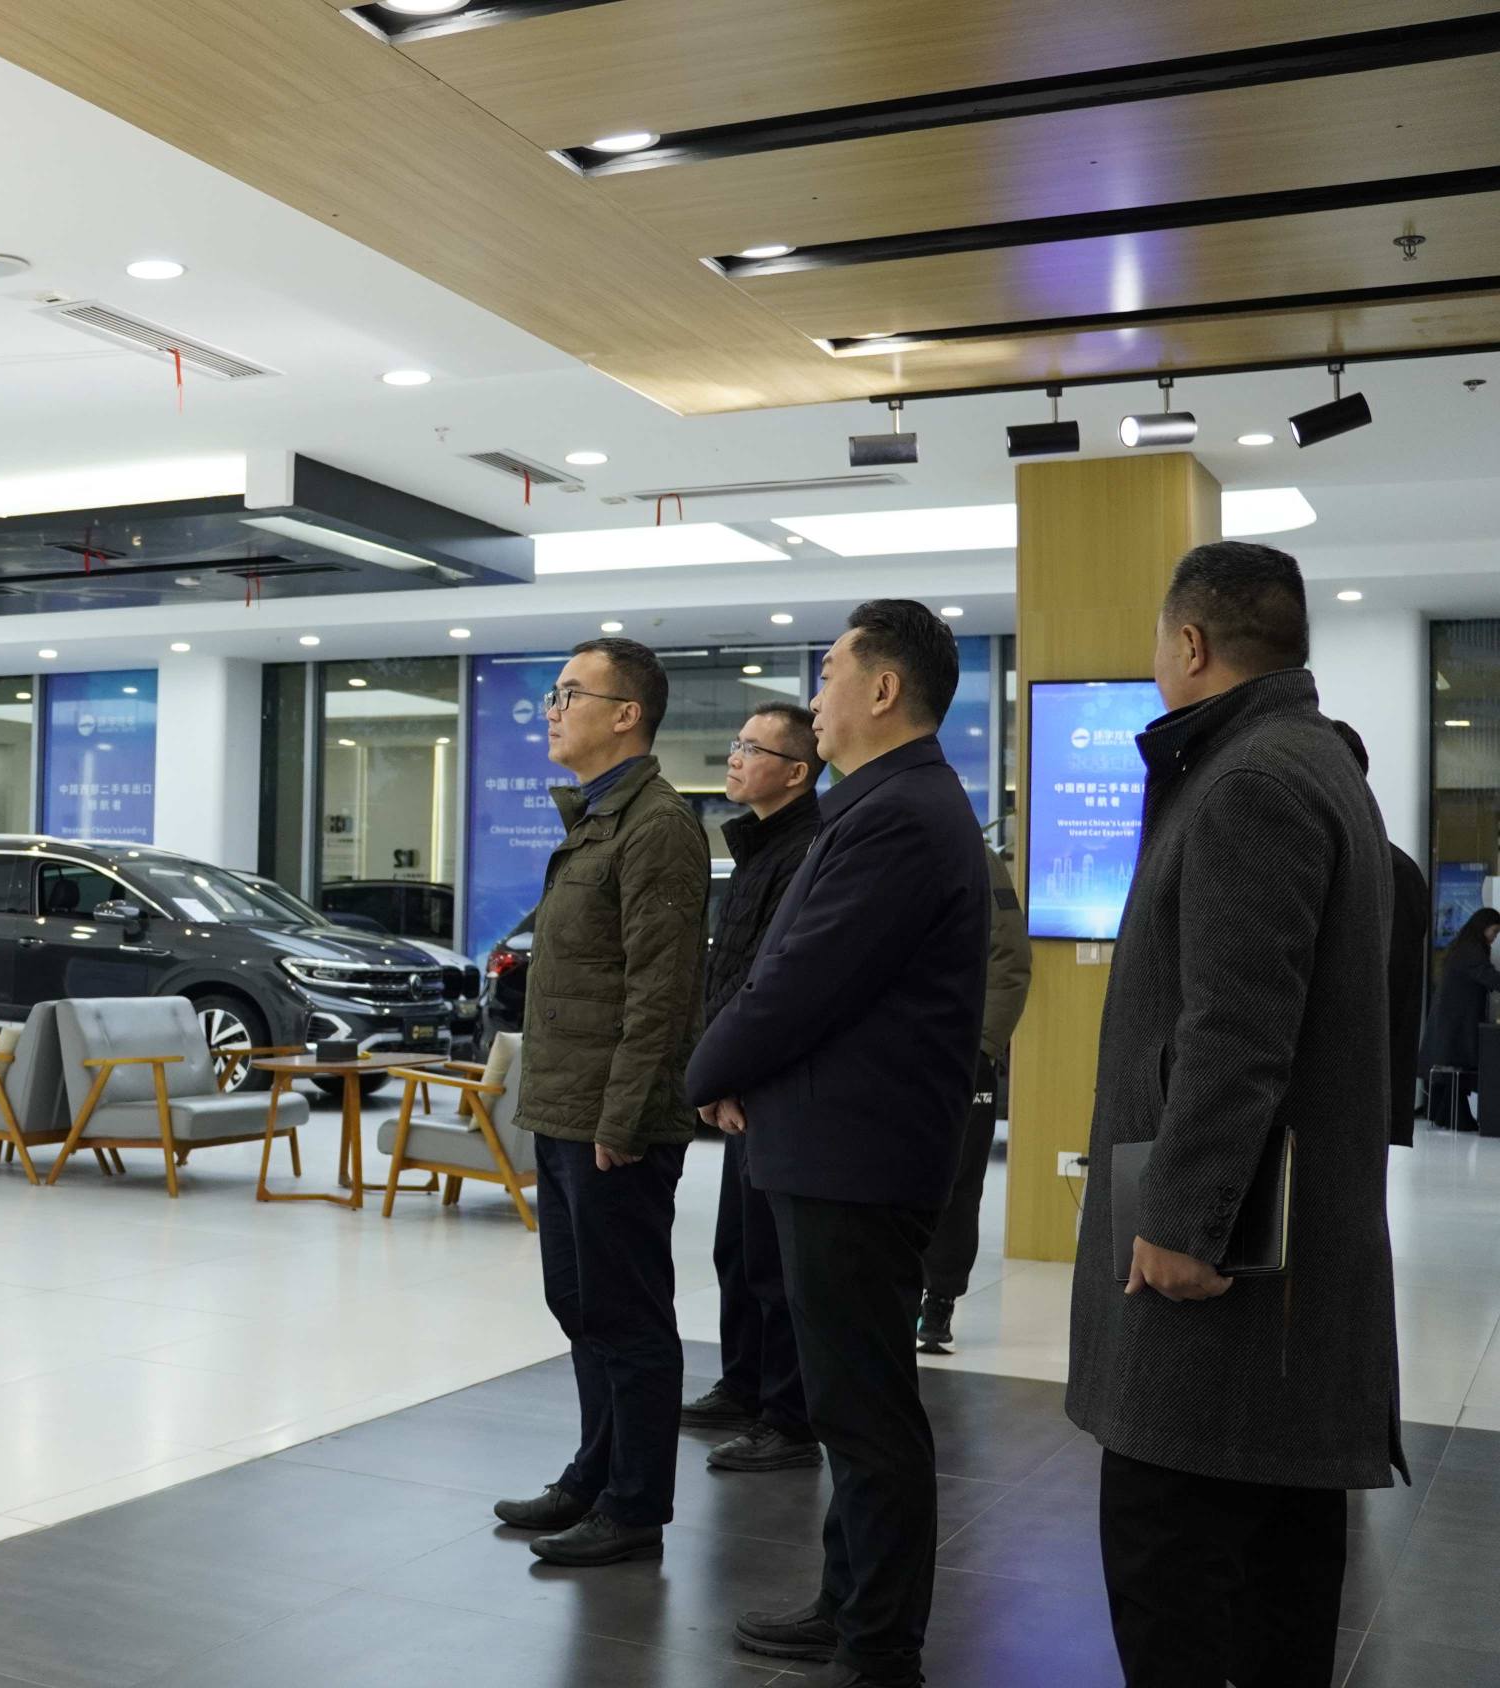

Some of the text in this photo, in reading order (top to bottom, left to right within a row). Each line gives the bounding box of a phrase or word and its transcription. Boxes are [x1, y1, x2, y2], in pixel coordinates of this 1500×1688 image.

[1054, 782, 1145, 794] 中国西部二手车出
[490, 825, 514, 835] China
[515, 825, 536, 835] Used
